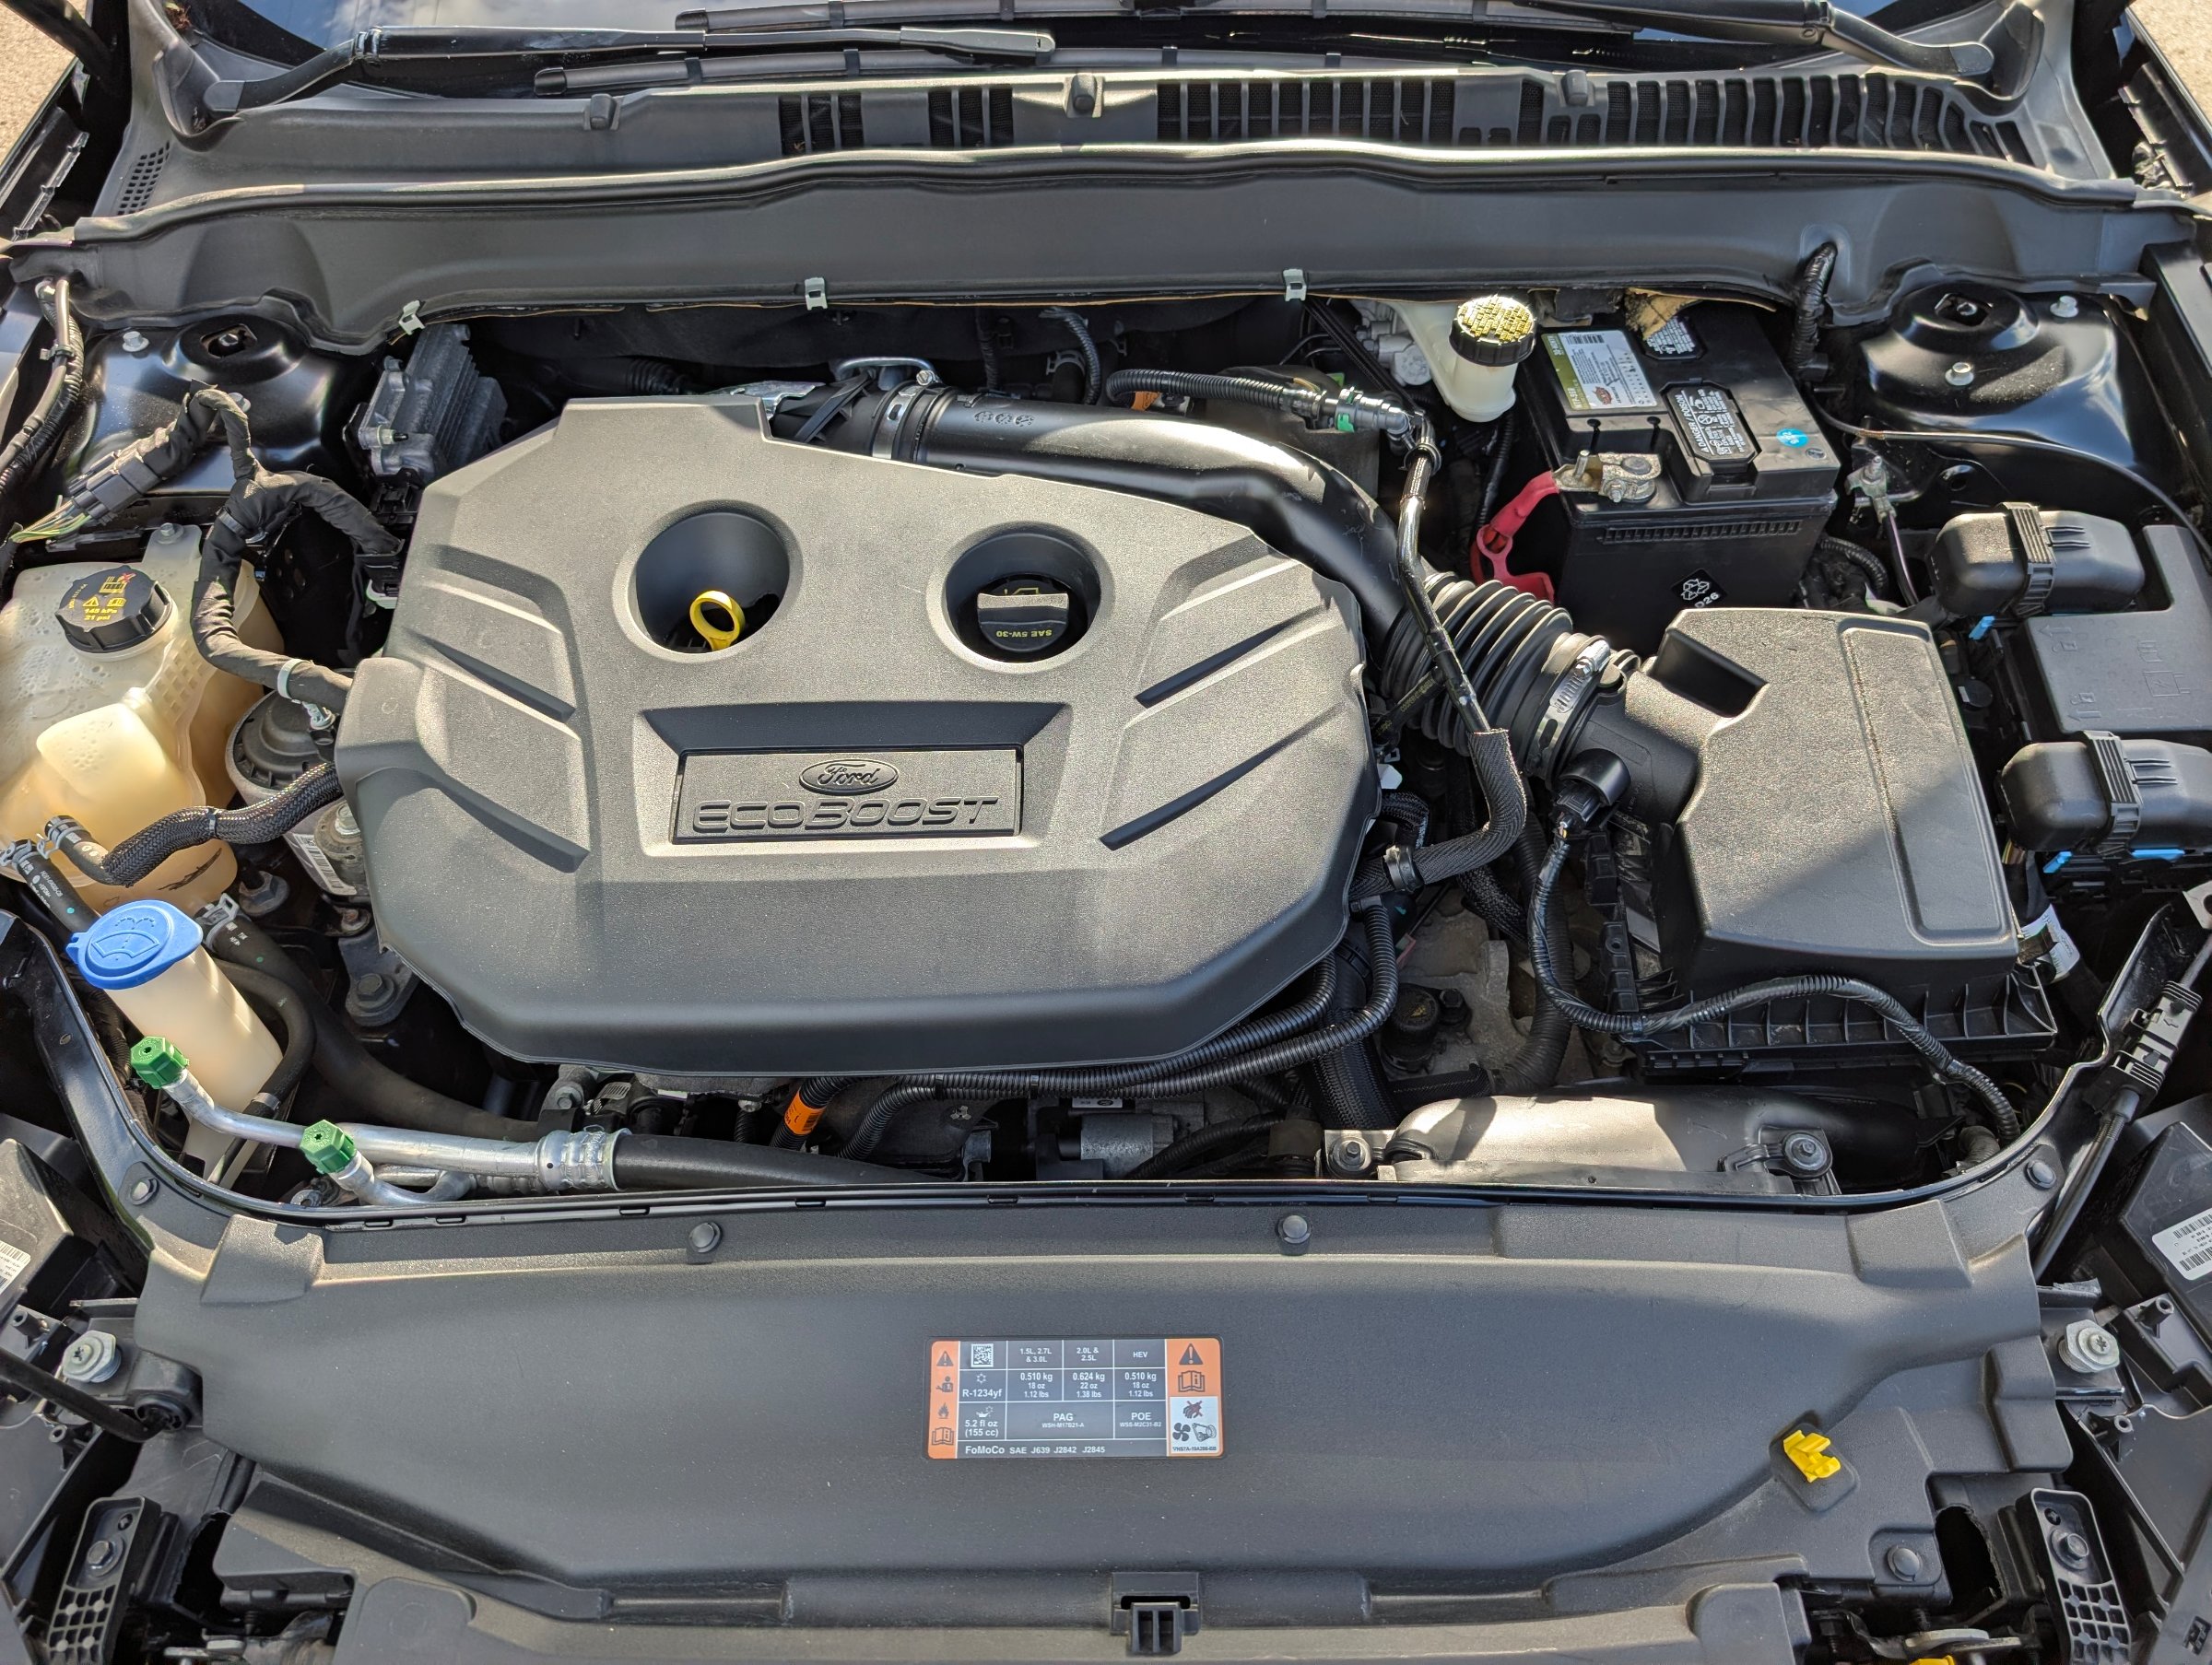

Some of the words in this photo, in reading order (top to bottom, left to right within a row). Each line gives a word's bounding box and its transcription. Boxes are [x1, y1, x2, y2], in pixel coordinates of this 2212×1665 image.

[1675, 394, 1692, 417] POISON
[1688, 422, 1708, 447] DANGER
[1694, 592, 1720, 608] D26
[1030, 629, 1053, 638] SAE
[817, 763, 879, 786] Ford
[693, 795, 999, 833] ECOBOOST
[1019, 1347, 1037, 1355] 1.5L,
[1037, 1347, 1053, 1355] 2.7L
[1042, 1372, 1053, 1382] kg
[1072, 1372, 1094, 1380] 0.624
[1095, 1372, 1105, 1382] kg
[1124, 1372, 1146, 1380] 0.510
[1147, 1371, 1157, 1381] kg
[962, 1389, 1003, 1399] R-1234yf
[1053, 1413, 1074, 1421] PAG
[1131, 1412, 1152, 1421] POE
[980, 1419, 986, 1427] fl
[965, 1428, 984, 1437] (155
[985, 1428, 999, 1437] cc)
[965, 1446, 1006, 1454] FoMoCo
